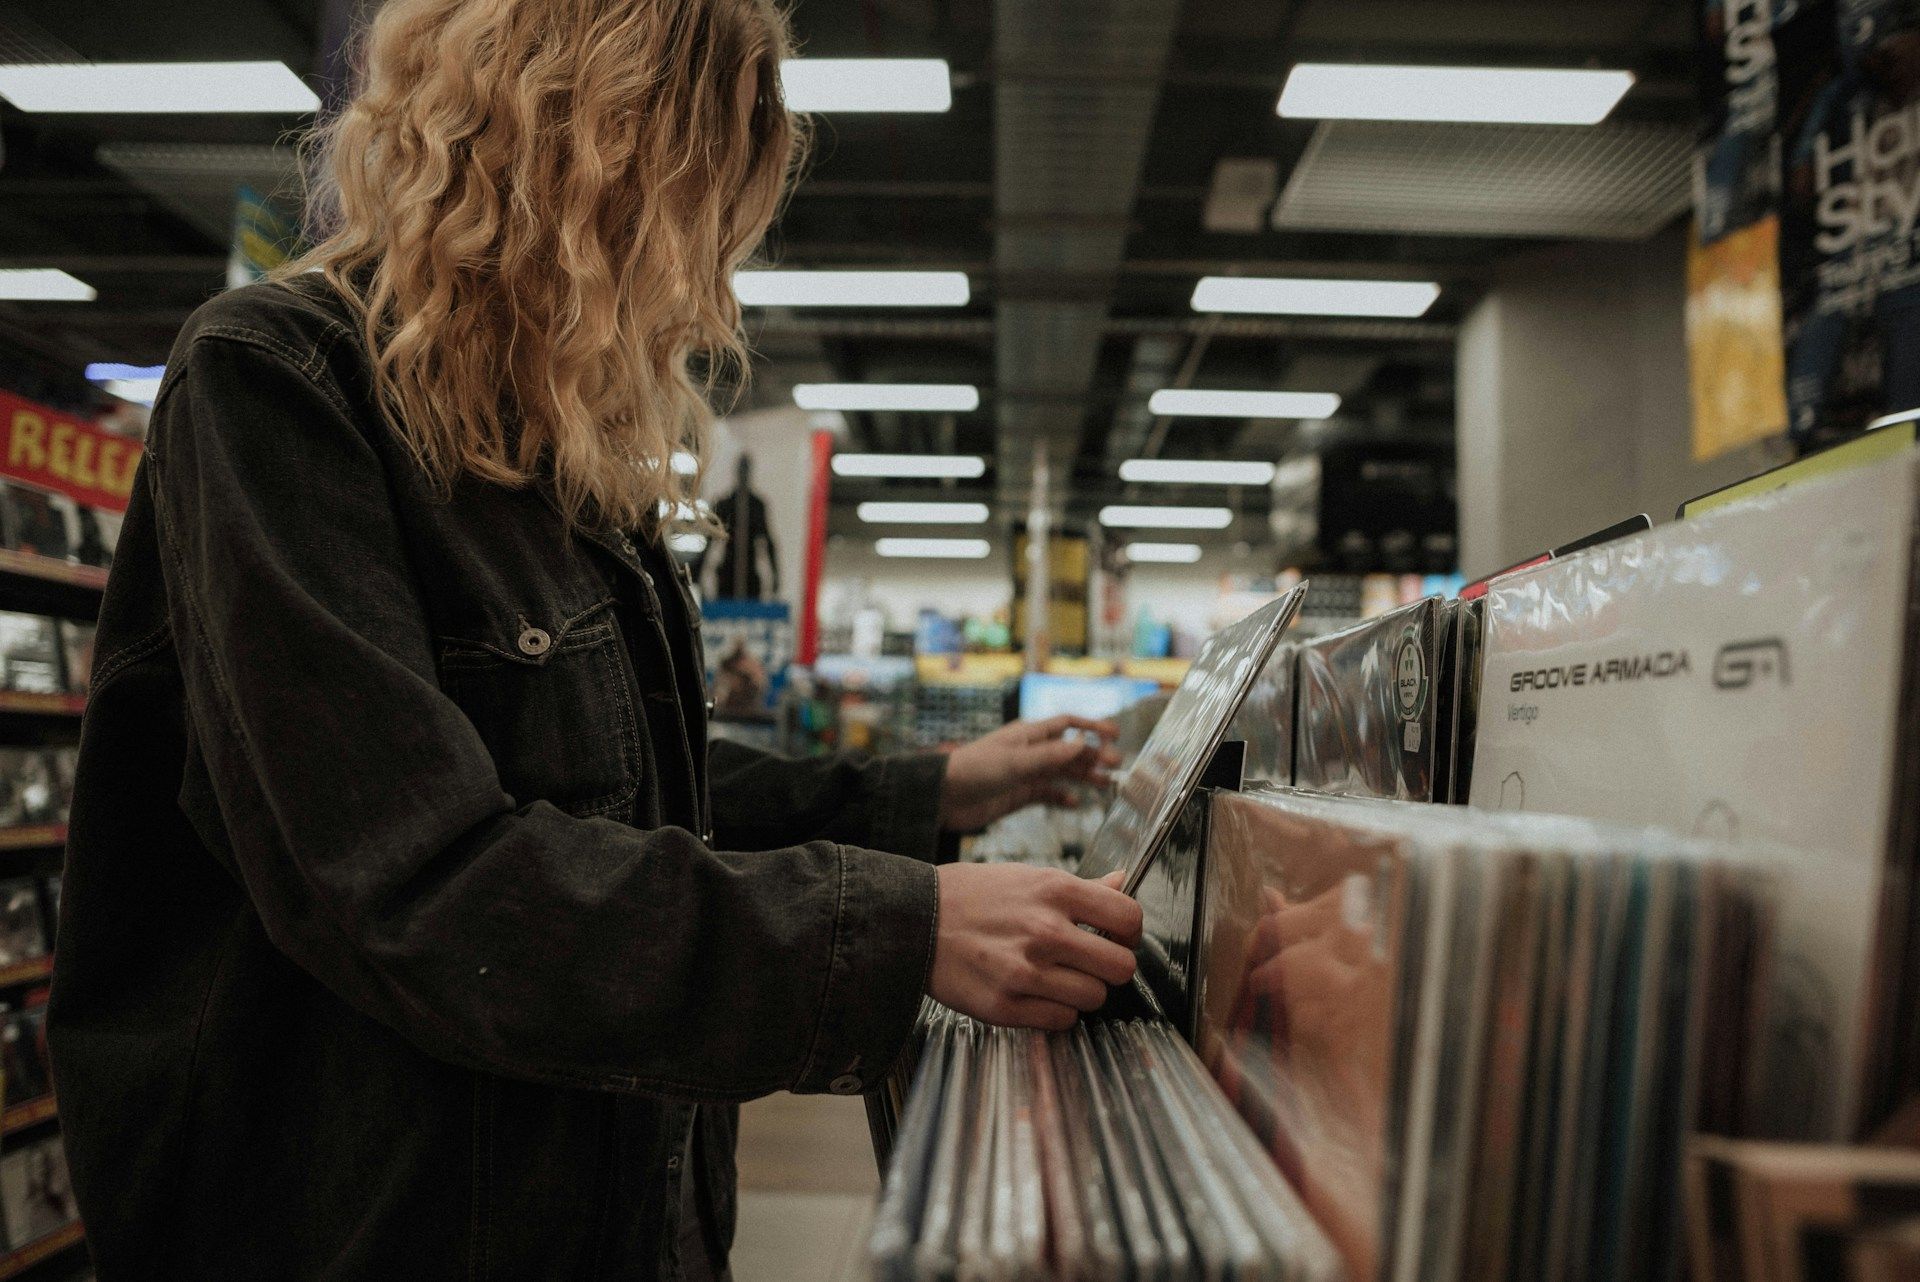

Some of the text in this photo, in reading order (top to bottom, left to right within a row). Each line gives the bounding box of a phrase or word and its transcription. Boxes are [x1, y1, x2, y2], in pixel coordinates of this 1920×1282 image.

[1510, 649, 1691, 692] GROOVE ARMADA
[1400, 678, 1416, 688] BLACK
[1507, 703, 1538, 725] Vertigo
